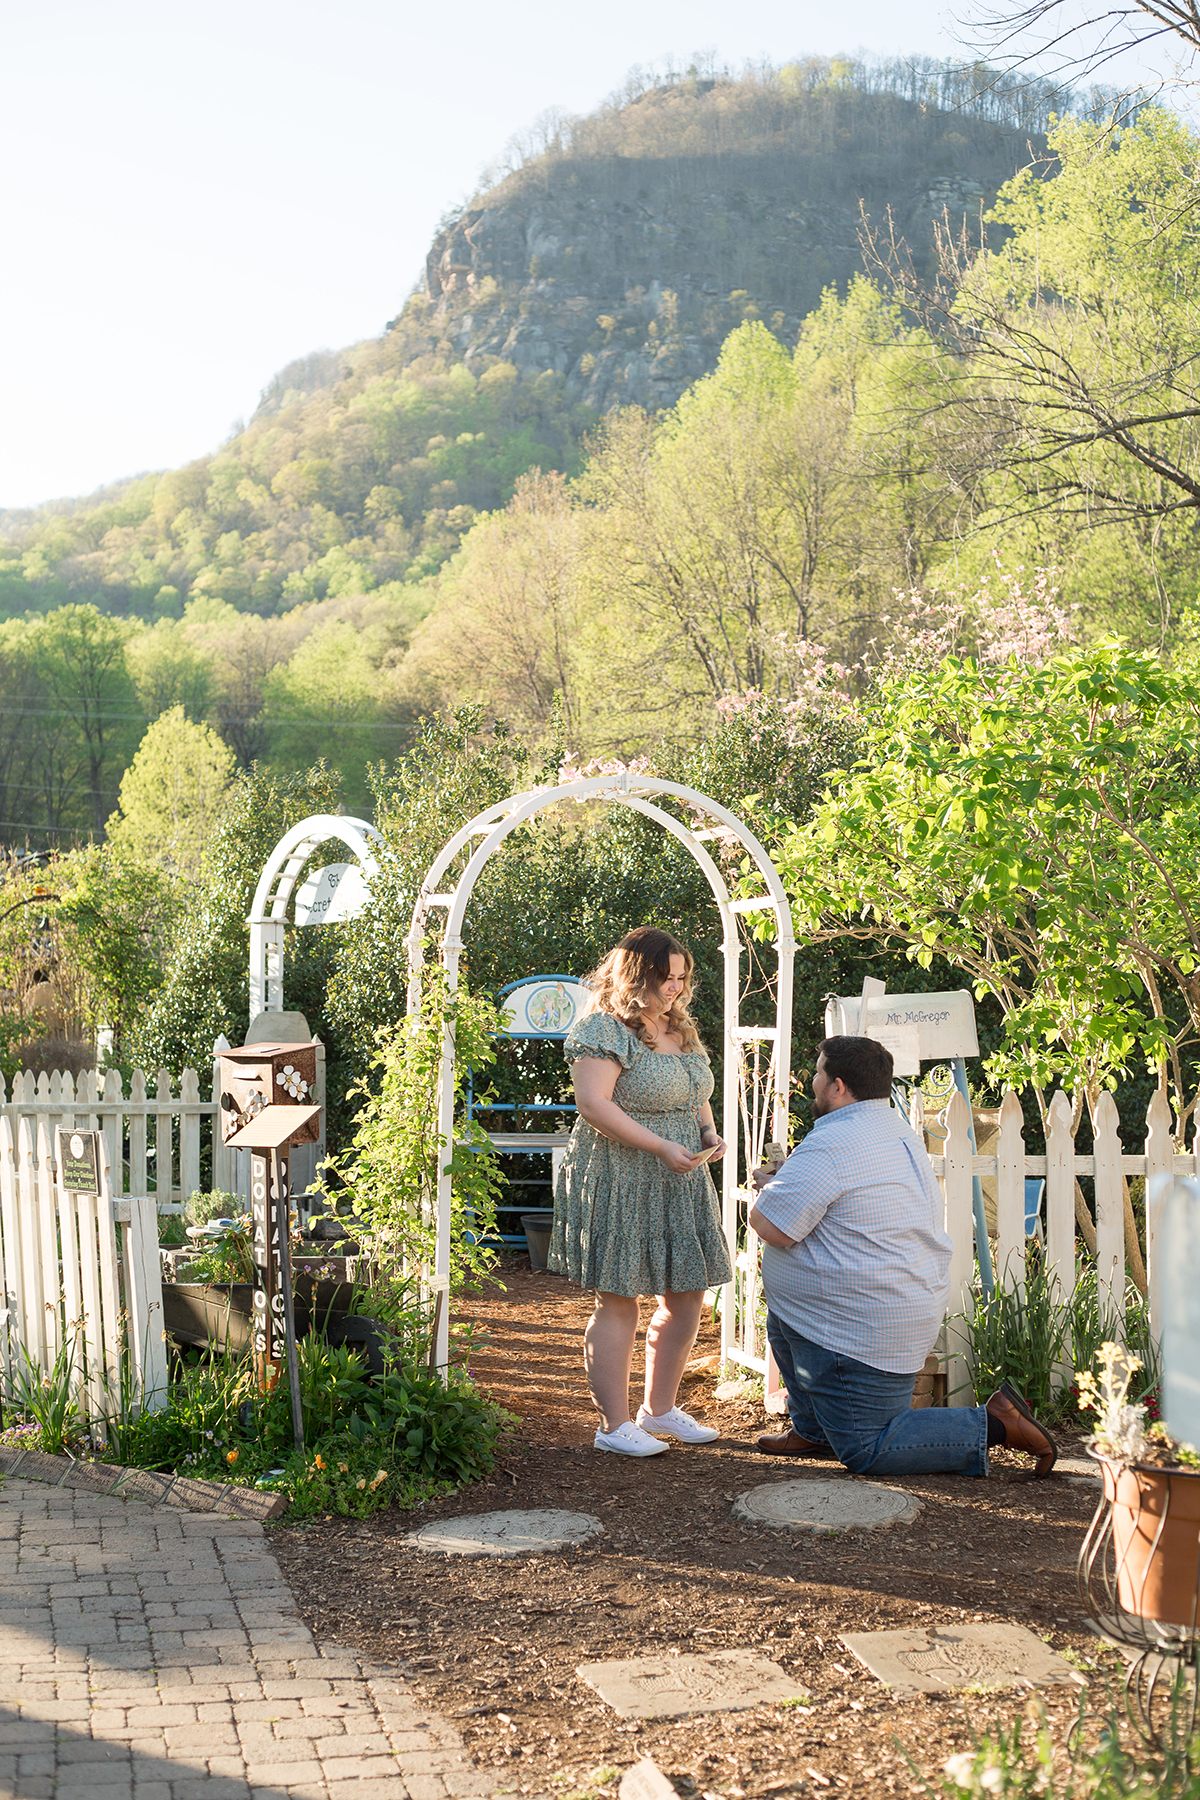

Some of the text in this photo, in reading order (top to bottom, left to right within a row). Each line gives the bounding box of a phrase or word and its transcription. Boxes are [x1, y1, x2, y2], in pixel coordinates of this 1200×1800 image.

[885, 1011, 950, 1026] Mr. McGregor
[253, 1160, 267, 1352] DONATIONS
